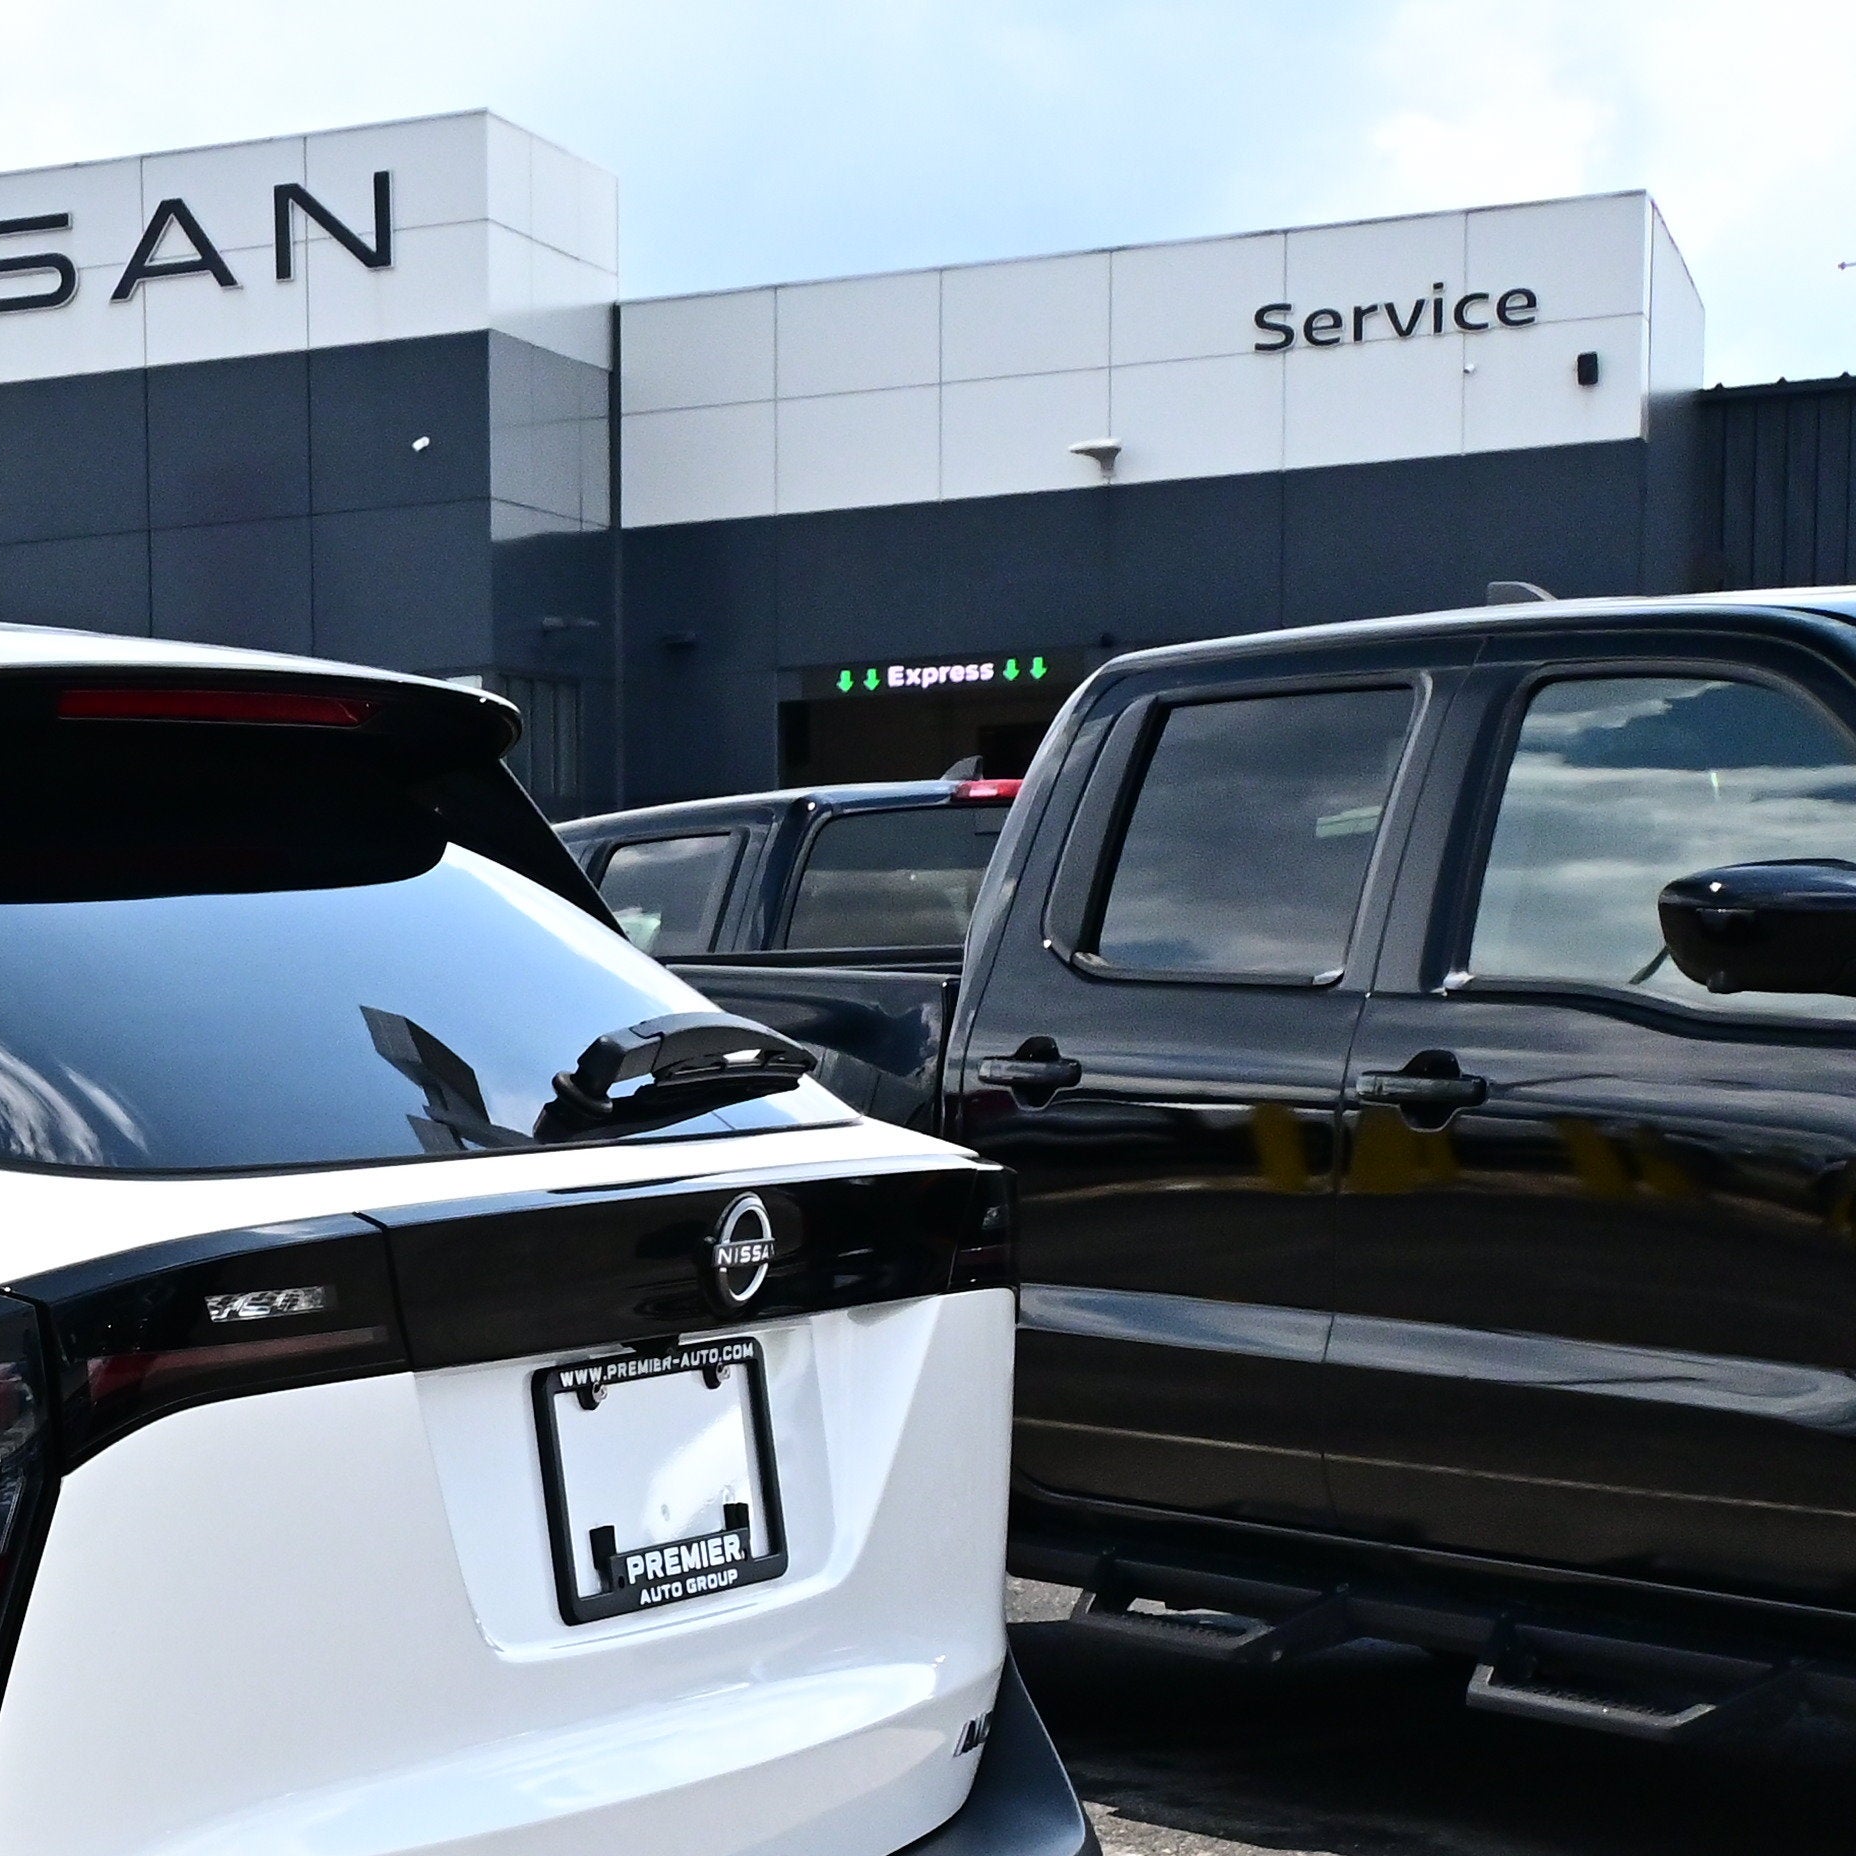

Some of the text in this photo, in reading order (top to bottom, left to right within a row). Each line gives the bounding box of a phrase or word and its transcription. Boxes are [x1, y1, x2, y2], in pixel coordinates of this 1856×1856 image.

[1253, 282, 1538, 352] Service
[888, 662, 995, 688] Express
[559, 1343, 754, 1388] WWW.PREMIER-AUTO.COM
[626, 1534, 742, 1584] PREMIER
[640, 1569, 738, 1605] AUTO GROUP
